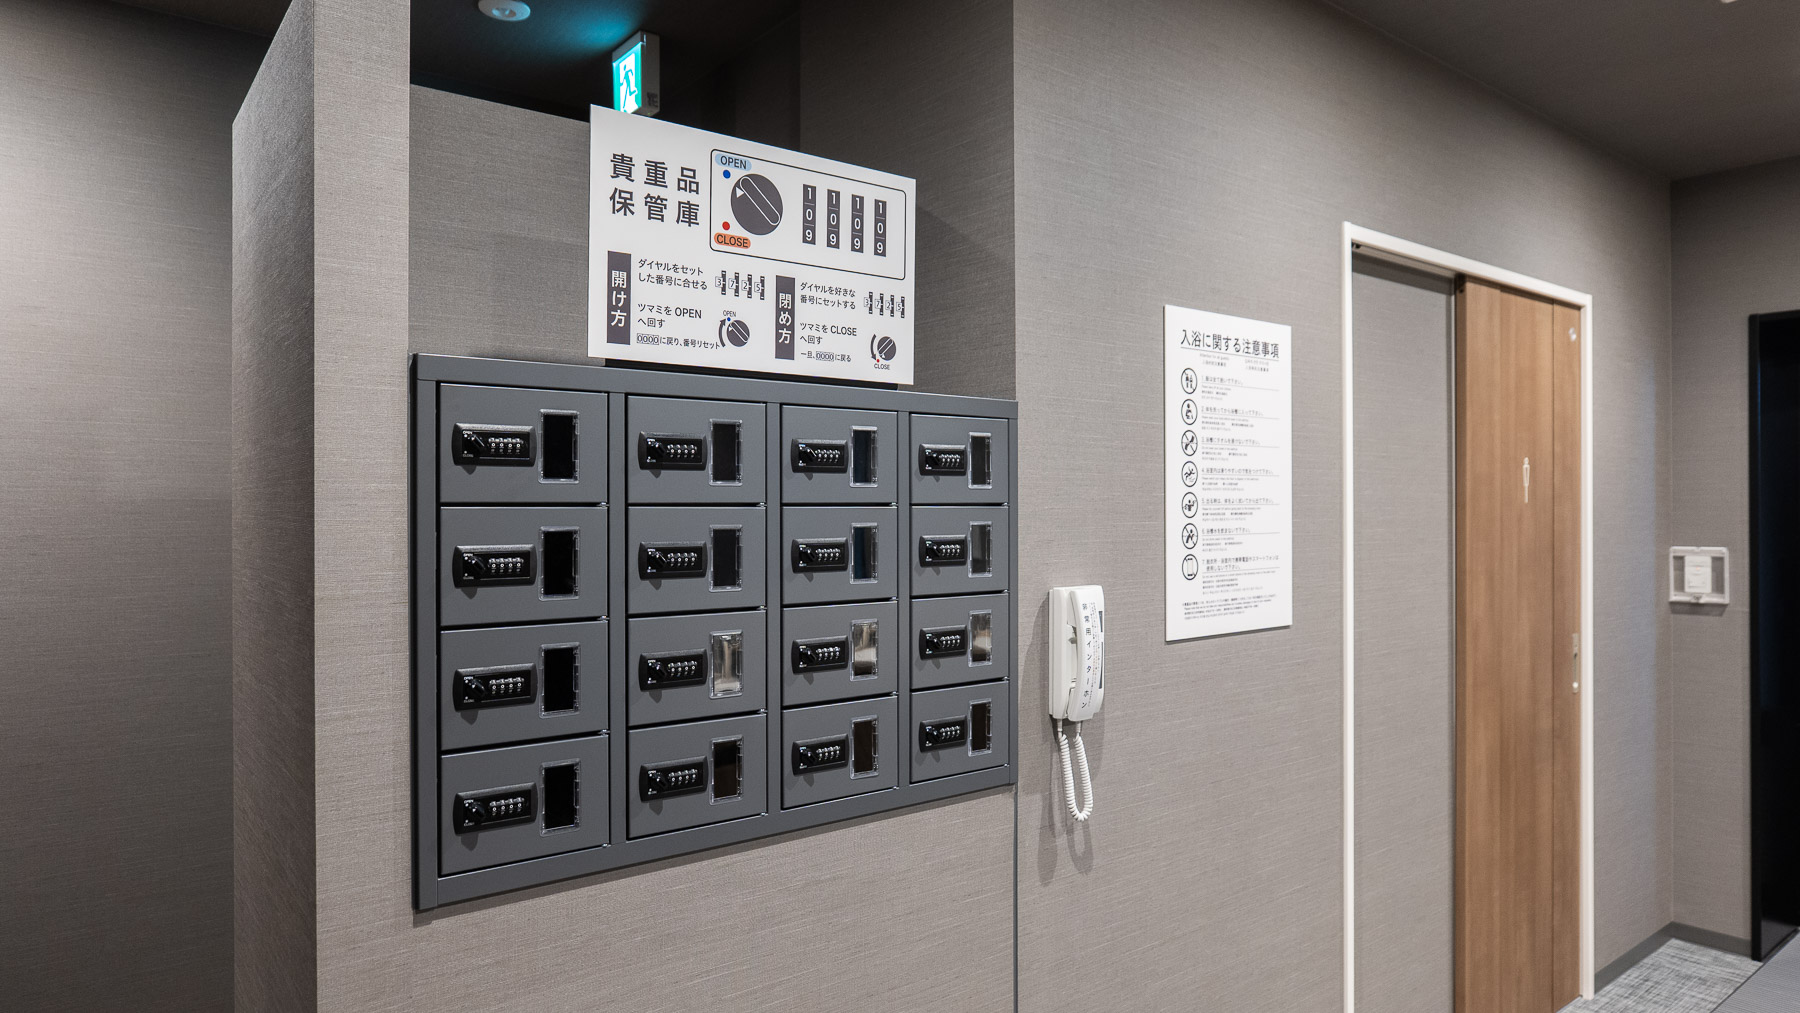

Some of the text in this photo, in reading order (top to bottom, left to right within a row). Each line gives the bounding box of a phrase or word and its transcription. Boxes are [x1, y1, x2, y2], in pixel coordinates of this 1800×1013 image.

[720, 155, 747, 170] OPEN
[609, 152, 700, 195] 貴重品
[609, 186, 700, 228] 保管庫
[716, 234, 749, 249] CLOSE
[638, 258, 704, 275] ダイヤルをセット
[638, 272, 708, 291] した番号に合せる
[800, 282, 856, 298] ダイヤルを好きな
[610, 270, 627, 327] 開け方
[800, 294, 856, 310] 番号にセットする
[637, 303, 702, 319] ツマミを OPEN
[723, 309, 737, 317] OPEN
[778, 292, 792, 344] 閉め方
[637, 317, 666, 329] へ回す
[799, 322, 857, 337] ツマミを CLOSE
[799, 334, 823, 345] へ回す
[1180, 329, 1279, 358] 入浴に関する注意事項
